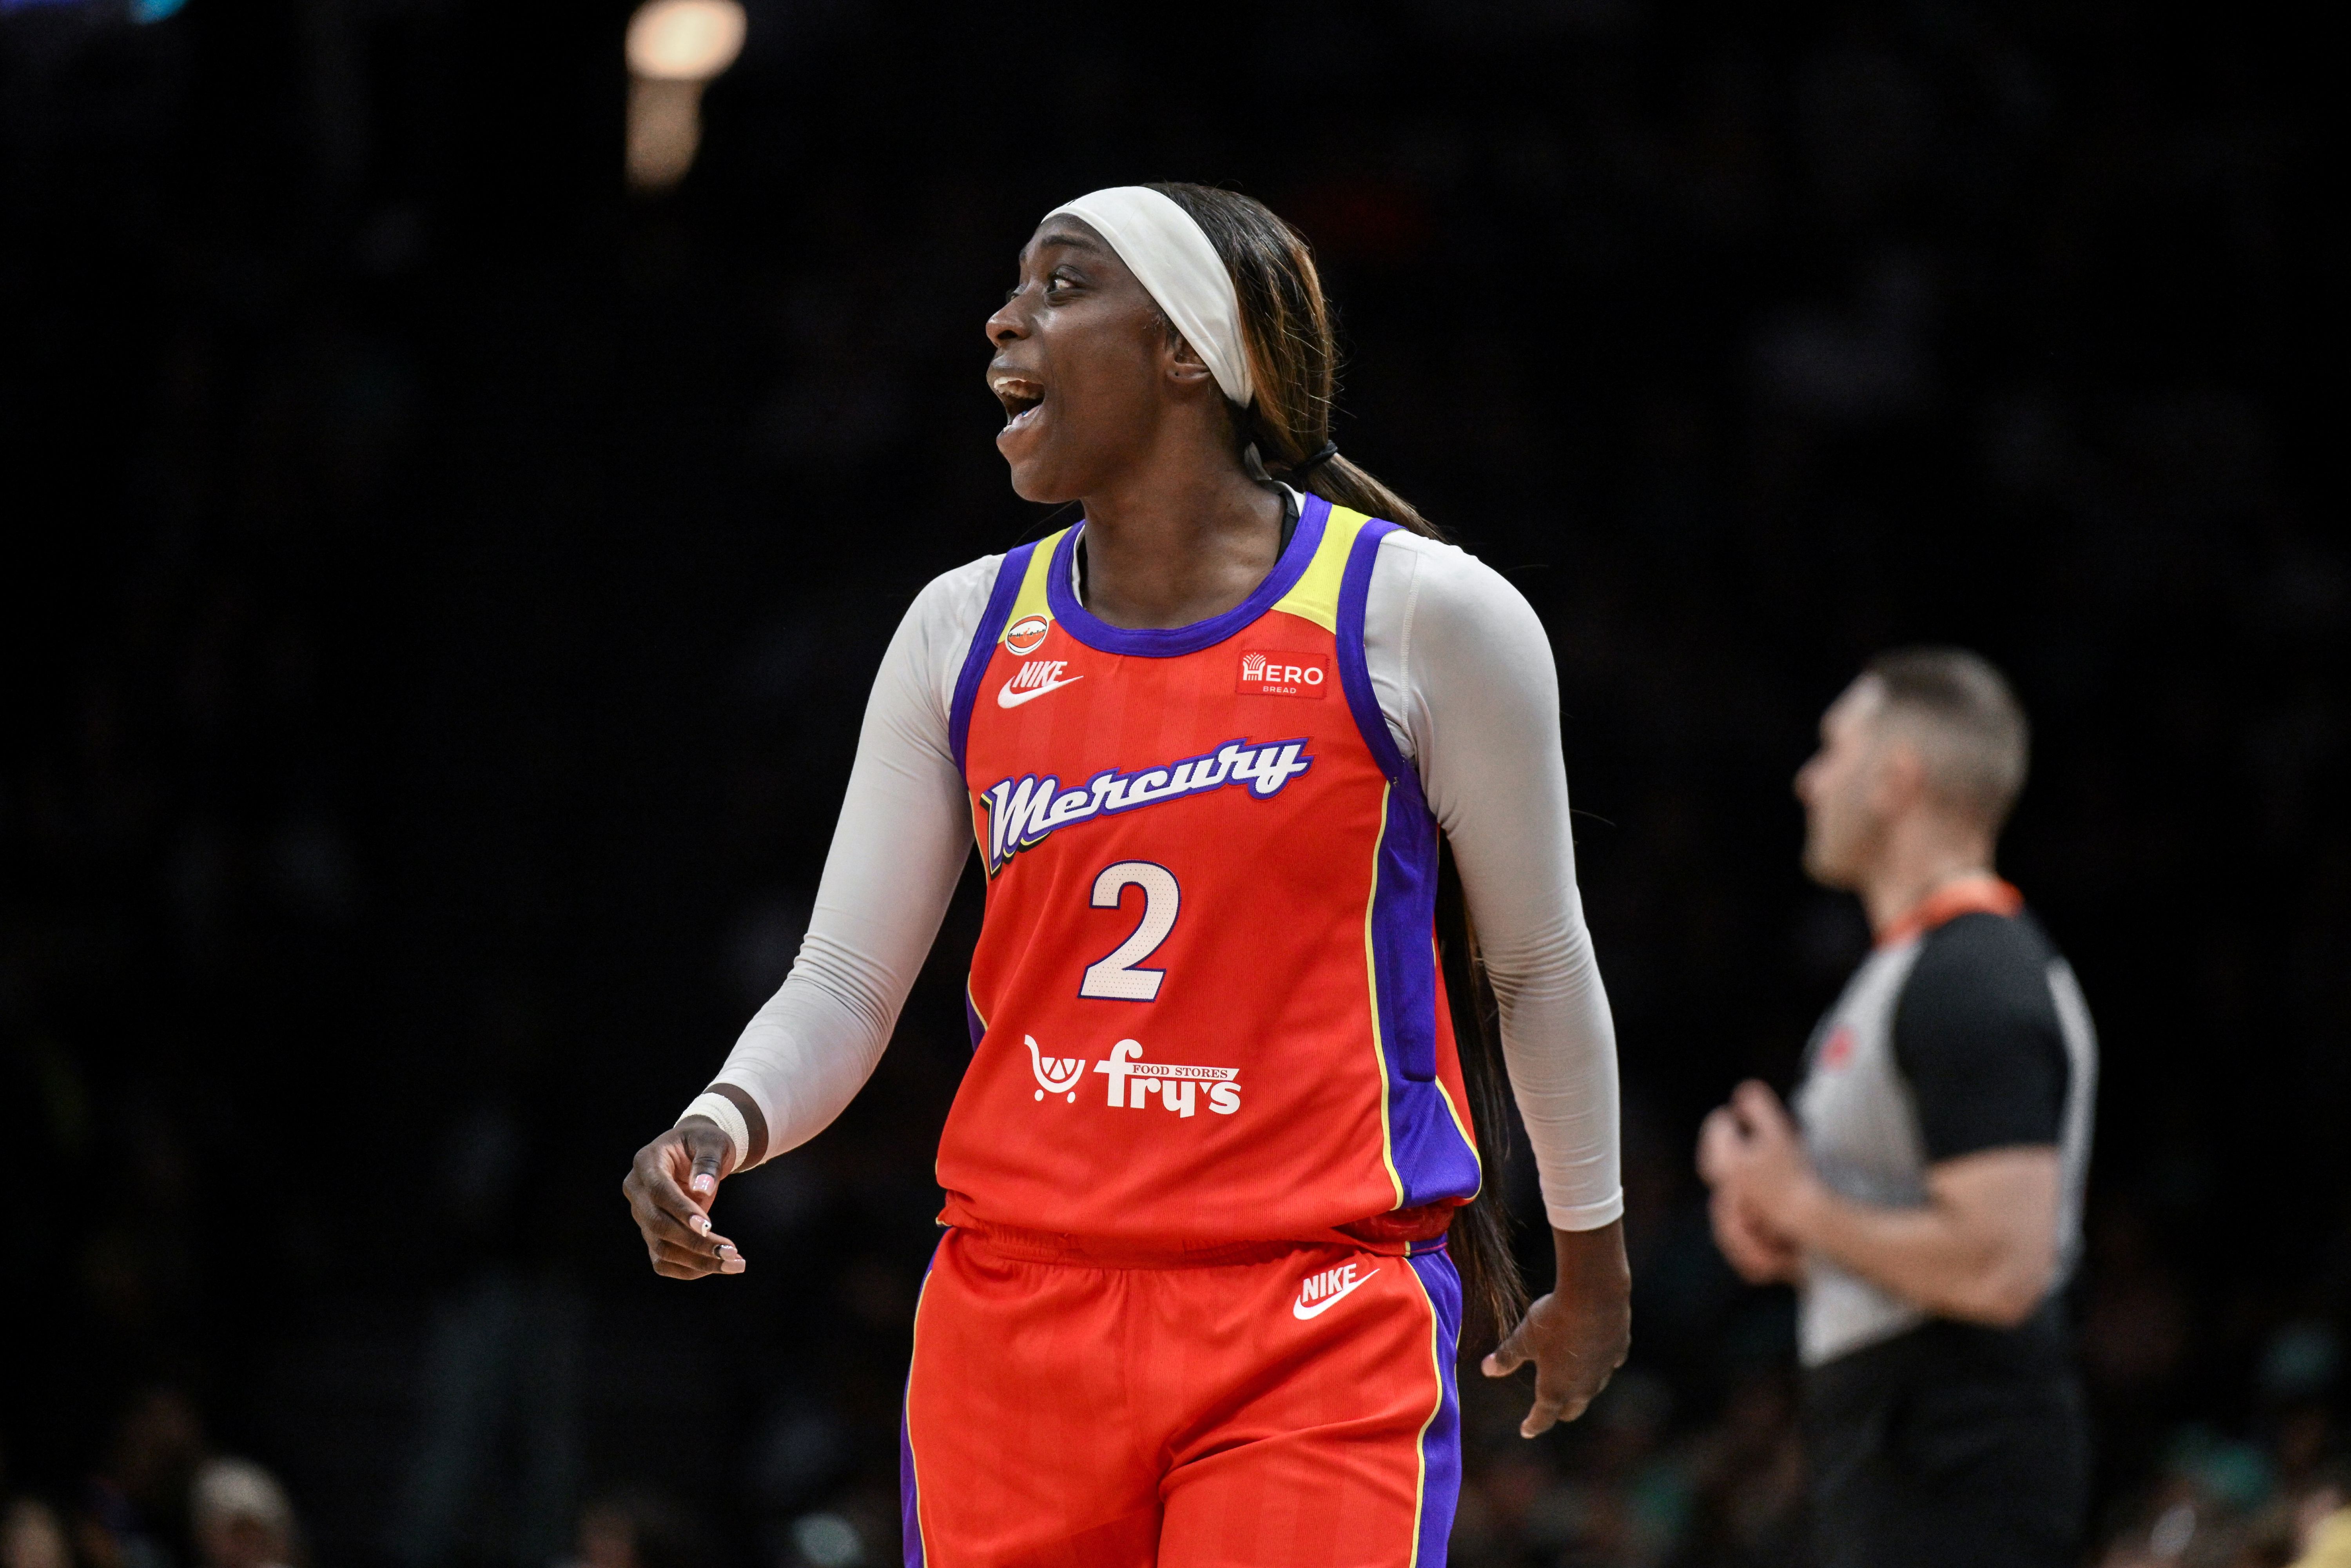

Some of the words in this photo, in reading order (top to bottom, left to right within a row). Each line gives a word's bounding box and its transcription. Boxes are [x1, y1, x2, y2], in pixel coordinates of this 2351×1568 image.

[1012, 661, 1068, 688] NIKE
[1243, 652, 1323, 685] HERO
[984, 737, 1314, 867] Mercury
[1078, 859, 1181, 1002] 2
[1132, 1064, 1170, 1076] FOOD
[1175, 1067, 1228, 1078] STORES
[1302, 1263, 1357, 1303] NIKE
